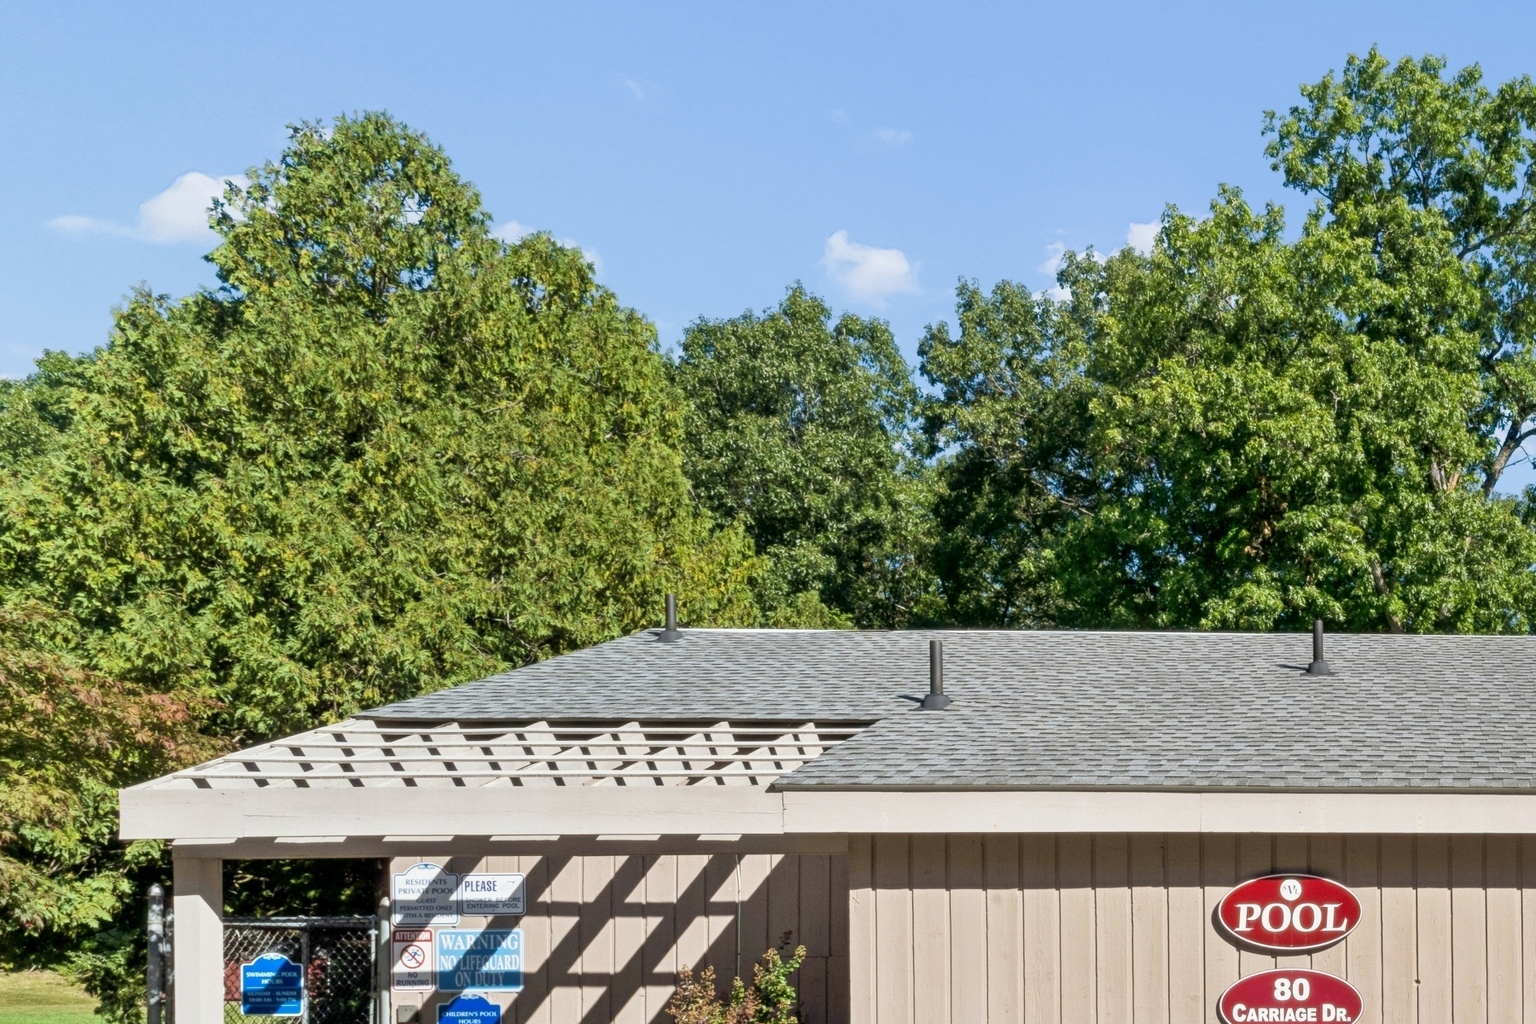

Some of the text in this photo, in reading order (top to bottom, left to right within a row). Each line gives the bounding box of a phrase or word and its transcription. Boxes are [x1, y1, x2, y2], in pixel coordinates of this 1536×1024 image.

[405, 878, 448, 886] RESIDENTS
[464, 880, 498, 892] PLEASE
[398, 887, 454, 895] PRIVATE POOL
[1234, 903, 1348, 932] POOL
[395, 931, 431, 941] ATTENTION
[440, 934, 519, 950] WARNING
[440, 954, 520, 971] NO LIFEGUARD
[407, 971, 418, 979] NO
[454, 971, 505, 987] ON DUTY
[396, 979, 430, 987] RUNNING
[1273, 977, 1311, 1001] 80
[1232, 1003, 1352, 1022] CARRIAGE DR.
